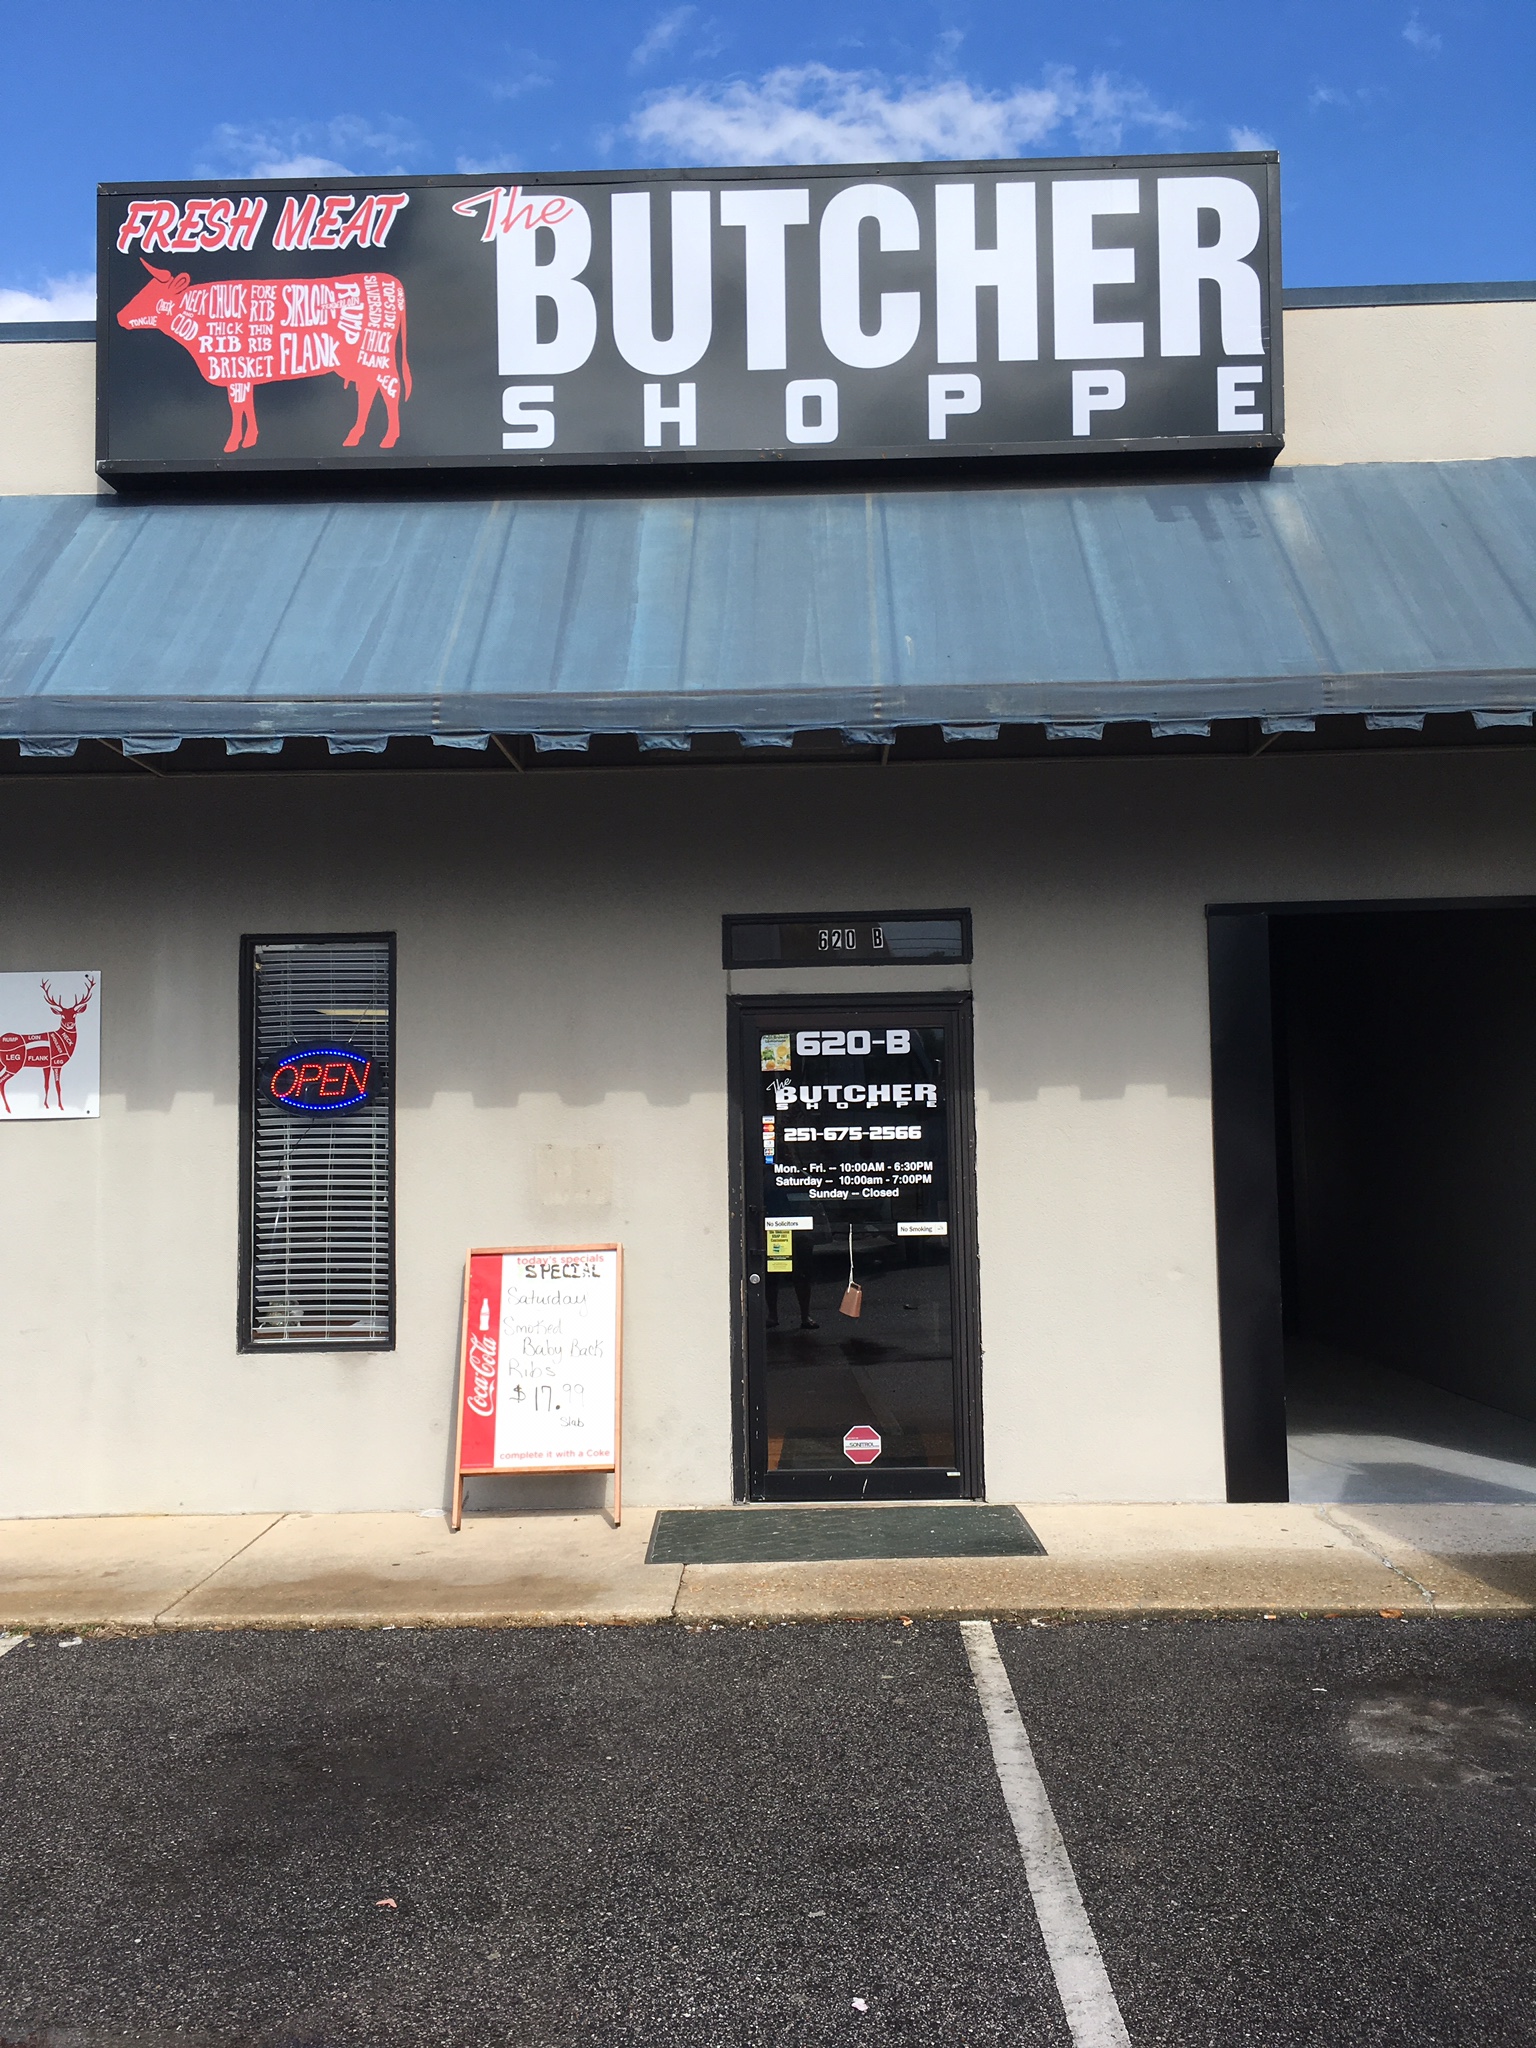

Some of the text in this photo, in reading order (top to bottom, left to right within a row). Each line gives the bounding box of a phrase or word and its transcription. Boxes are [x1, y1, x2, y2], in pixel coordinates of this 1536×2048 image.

[117, 193, 410, 254] FRESH MEAT
[453, 185, 574, 242] The
[496, 176, 1266, 376] BUTCHER
[179, 289, 209, 316] NECK
[208, 283, 248, 319] CHUCK
[251, 284, 278, 300] FORE
[363, 275, 383, 329] SILVERSIDE
[249, 300, 275, 323] RIB
[280, 283, 337, 328] SIRLOIN
[334, 281, 365, 345] RUMP
[381, 281, 397, 330] TOPSIDE
[128, 315, 158, 328] TONGUE
[170, 313, 199, 341] CLOD
[206, 321, 244, 336] THICK
[248, 324, 274, 337] THIN
[197, 335, 242, 353] RIB
[247, 337, 273, 354] RIB
[360, 327, 393, 354] THICK
[279, 332, 341, 375] FLANK
[357, 350, 391, 370] FLANK
[207, 355, 274, 380] BRISKET
[229, 381, 252, 404] SHIN
[376, 373, 399, 399] LEG
[502, 366, 1264, 450] SHOPPE
[818, 927, 884, 950] 620 B
[61, 1032, 74, 1046] NECK
[796, 1030, 911, 1056] 620-B
[270, 1061, 372, 1099] OPEN
[765, 1077, 792, 1096] The
[775, 1083, 938, 1104] BUTCHER
[776, 1100, 938, 1111] SHOPPE
[783, 1125, 922, 1142] 251-675-2566
[774, 1163, 800, 1174] Mon.
[809, 1163, 827, 1173] Fri.
[839, 1161, 885, 1173] 10:00AM
[893, 1161, 934, 1172] 6:30PM
[775, 1176, 823, 1188] Saturday
[839, 1174, 884, 1186] 10:00am
[892, 1173, 933, 1185] 7:00PM
[808, 1188, 849, 1201] Sunday
[861, 1187, 900, 1198] Closed
[517, 1254, 604, 1266] today's specials
[525, 1263, 601, 1279] SPECIAL
[507, 1286, 588, 1318] Saturday
[503, 1315, 563, 1336] Smoked
[523, 1336, 604, 1365] Baby Back
[508, 1358, 556, 1379] Ribs
[560, 1416, 585, 1428] Slab
[499, 1451, 544, 1460] complete
[546, 1450, 553, 1458] it
[555, 1449, 576, 1458] with
[586, 1449, 611, 1458] Coke
